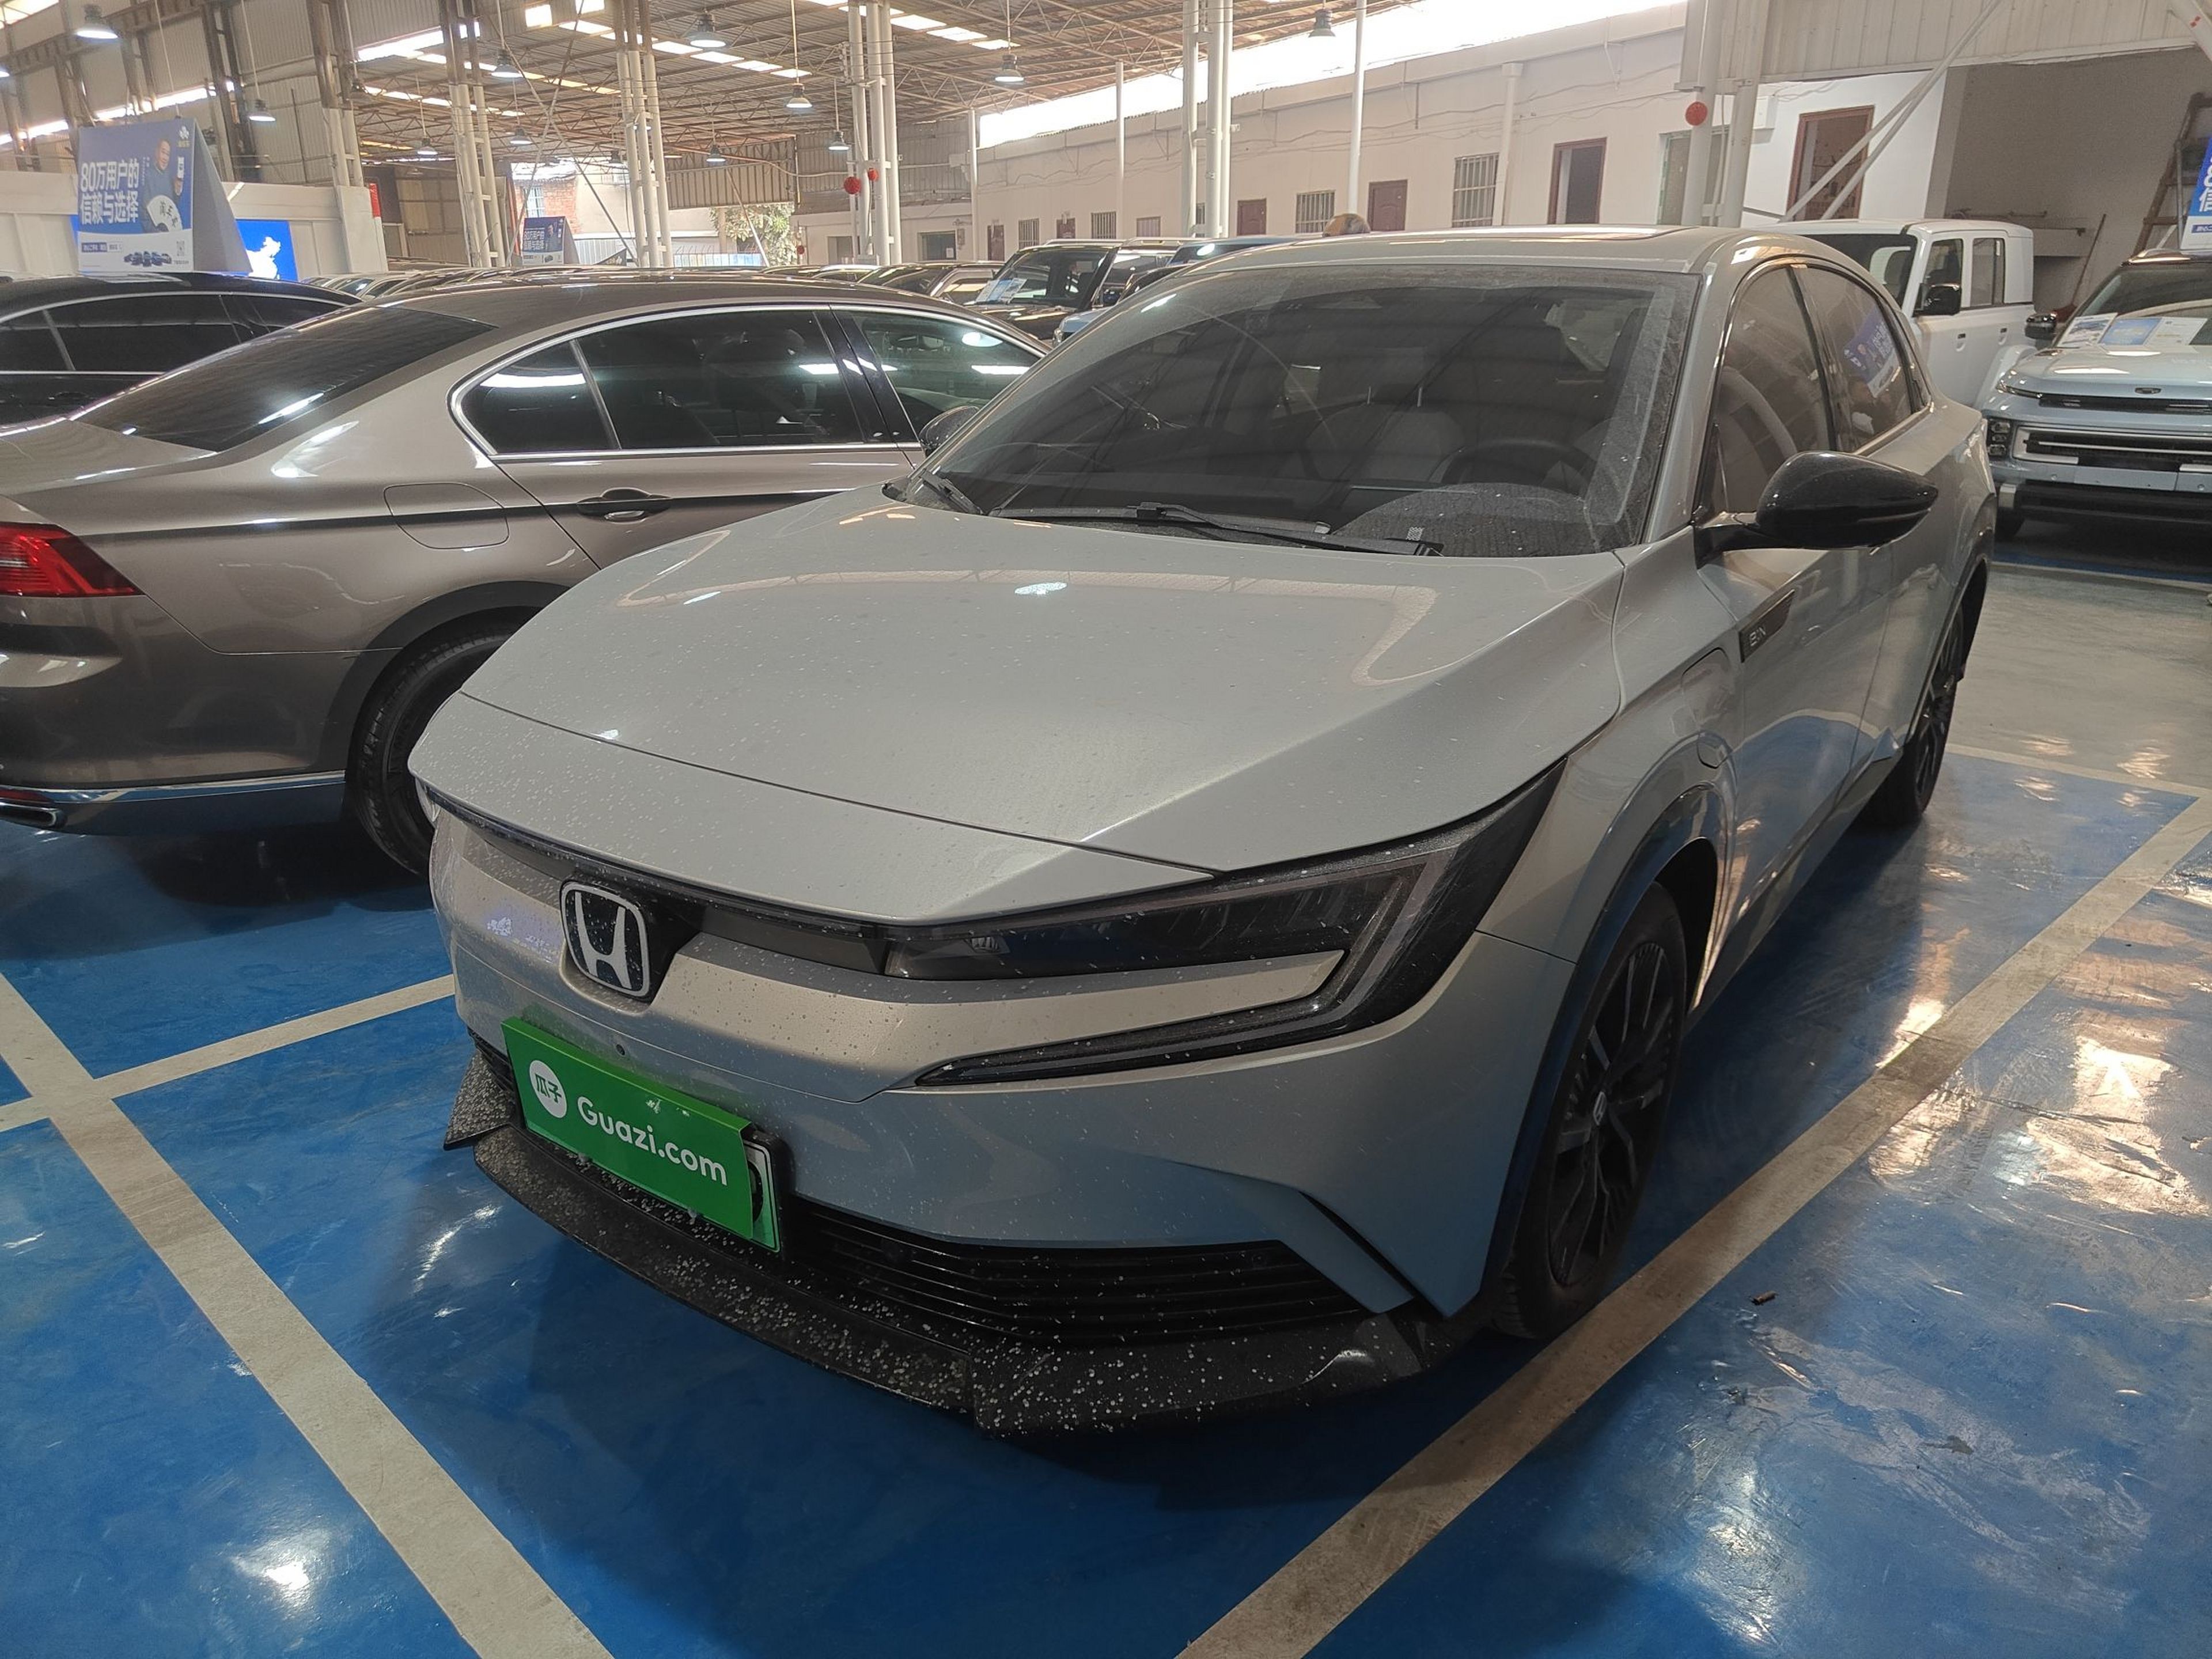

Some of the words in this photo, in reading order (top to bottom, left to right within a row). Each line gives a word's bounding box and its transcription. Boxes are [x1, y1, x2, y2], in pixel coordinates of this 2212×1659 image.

[81, 158, 139, 192] 80万用户的
[80, 191, 139, 225] 信赖与选择
[535, 1074, 562, 1104] 瓜子
[577, 1096, 727, 1186] Guazi.com
